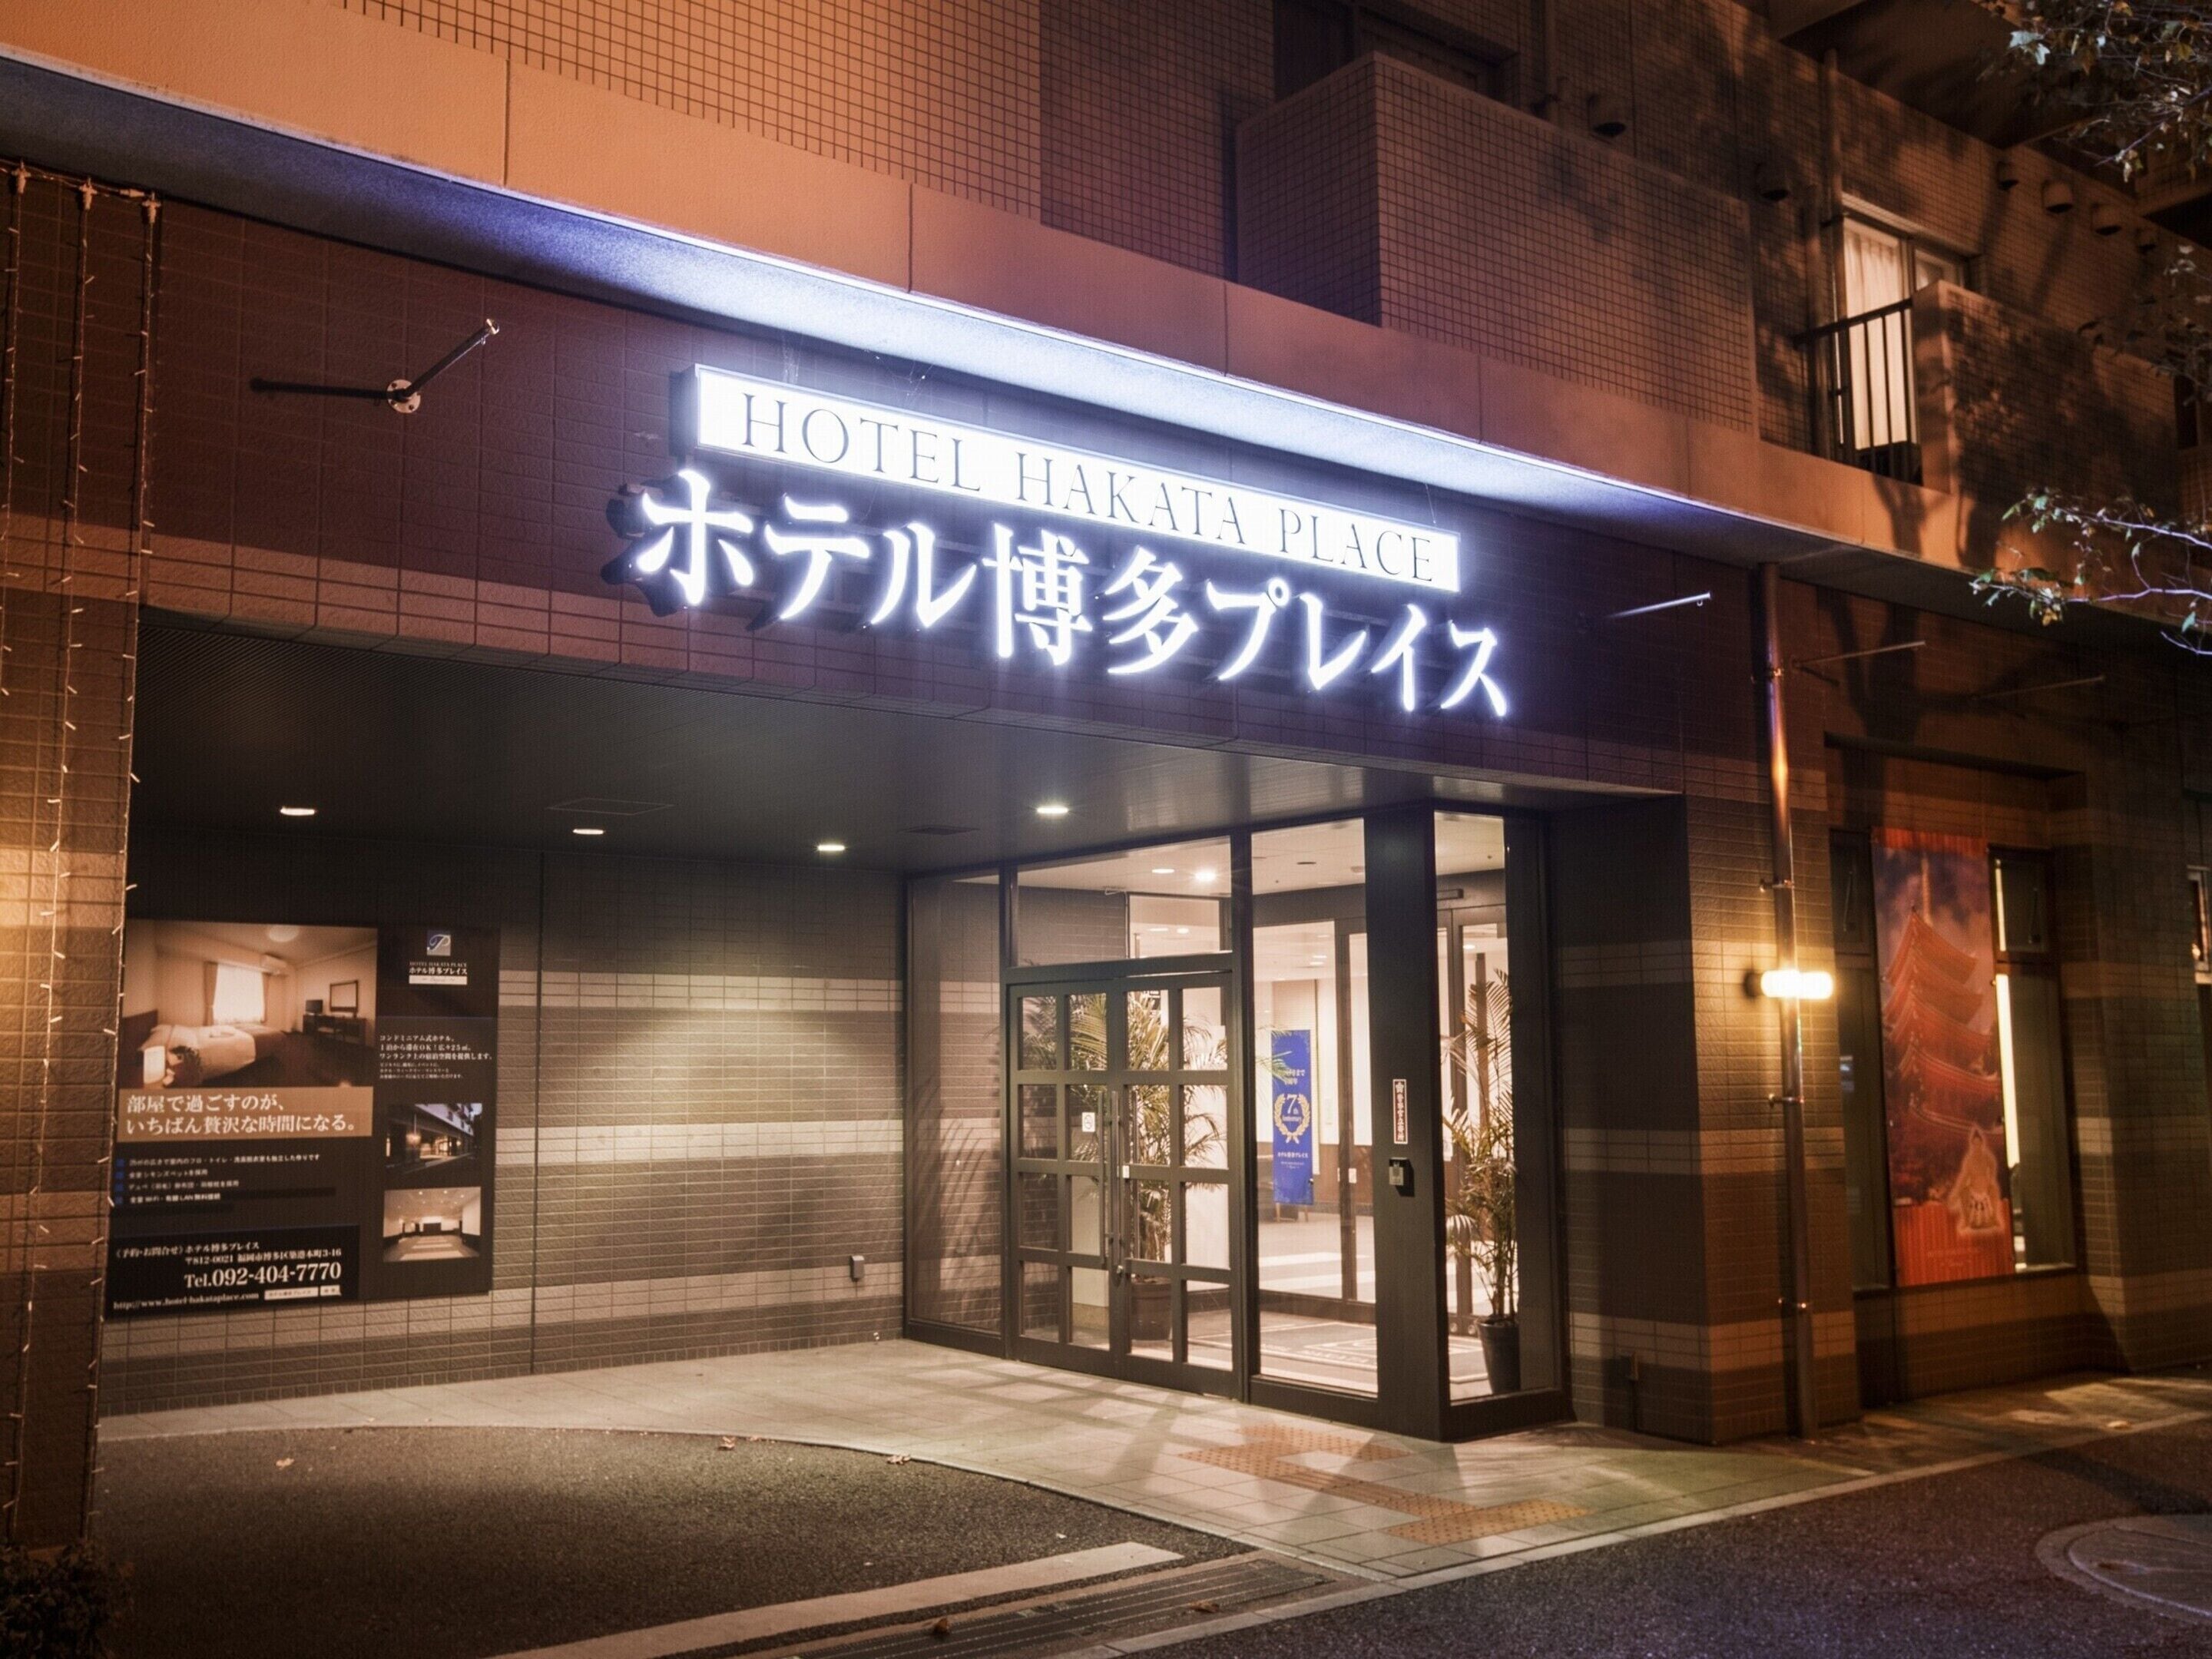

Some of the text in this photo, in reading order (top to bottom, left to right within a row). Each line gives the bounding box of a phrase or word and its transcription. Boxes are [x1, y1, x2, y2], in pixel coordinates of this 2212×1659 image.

[742, 392, 1433, 581] HOTEL HAKATA PLACE
[635, 469, 1508, 717] ホテル博多プレイス
[409, 967, 468, 975] ホテル博多プレイス
[127, 1094, 284, 1114] 部屋で過ごすのが、
[126, 1114, 356, 1135] いちばん贅沢な時間になる。
